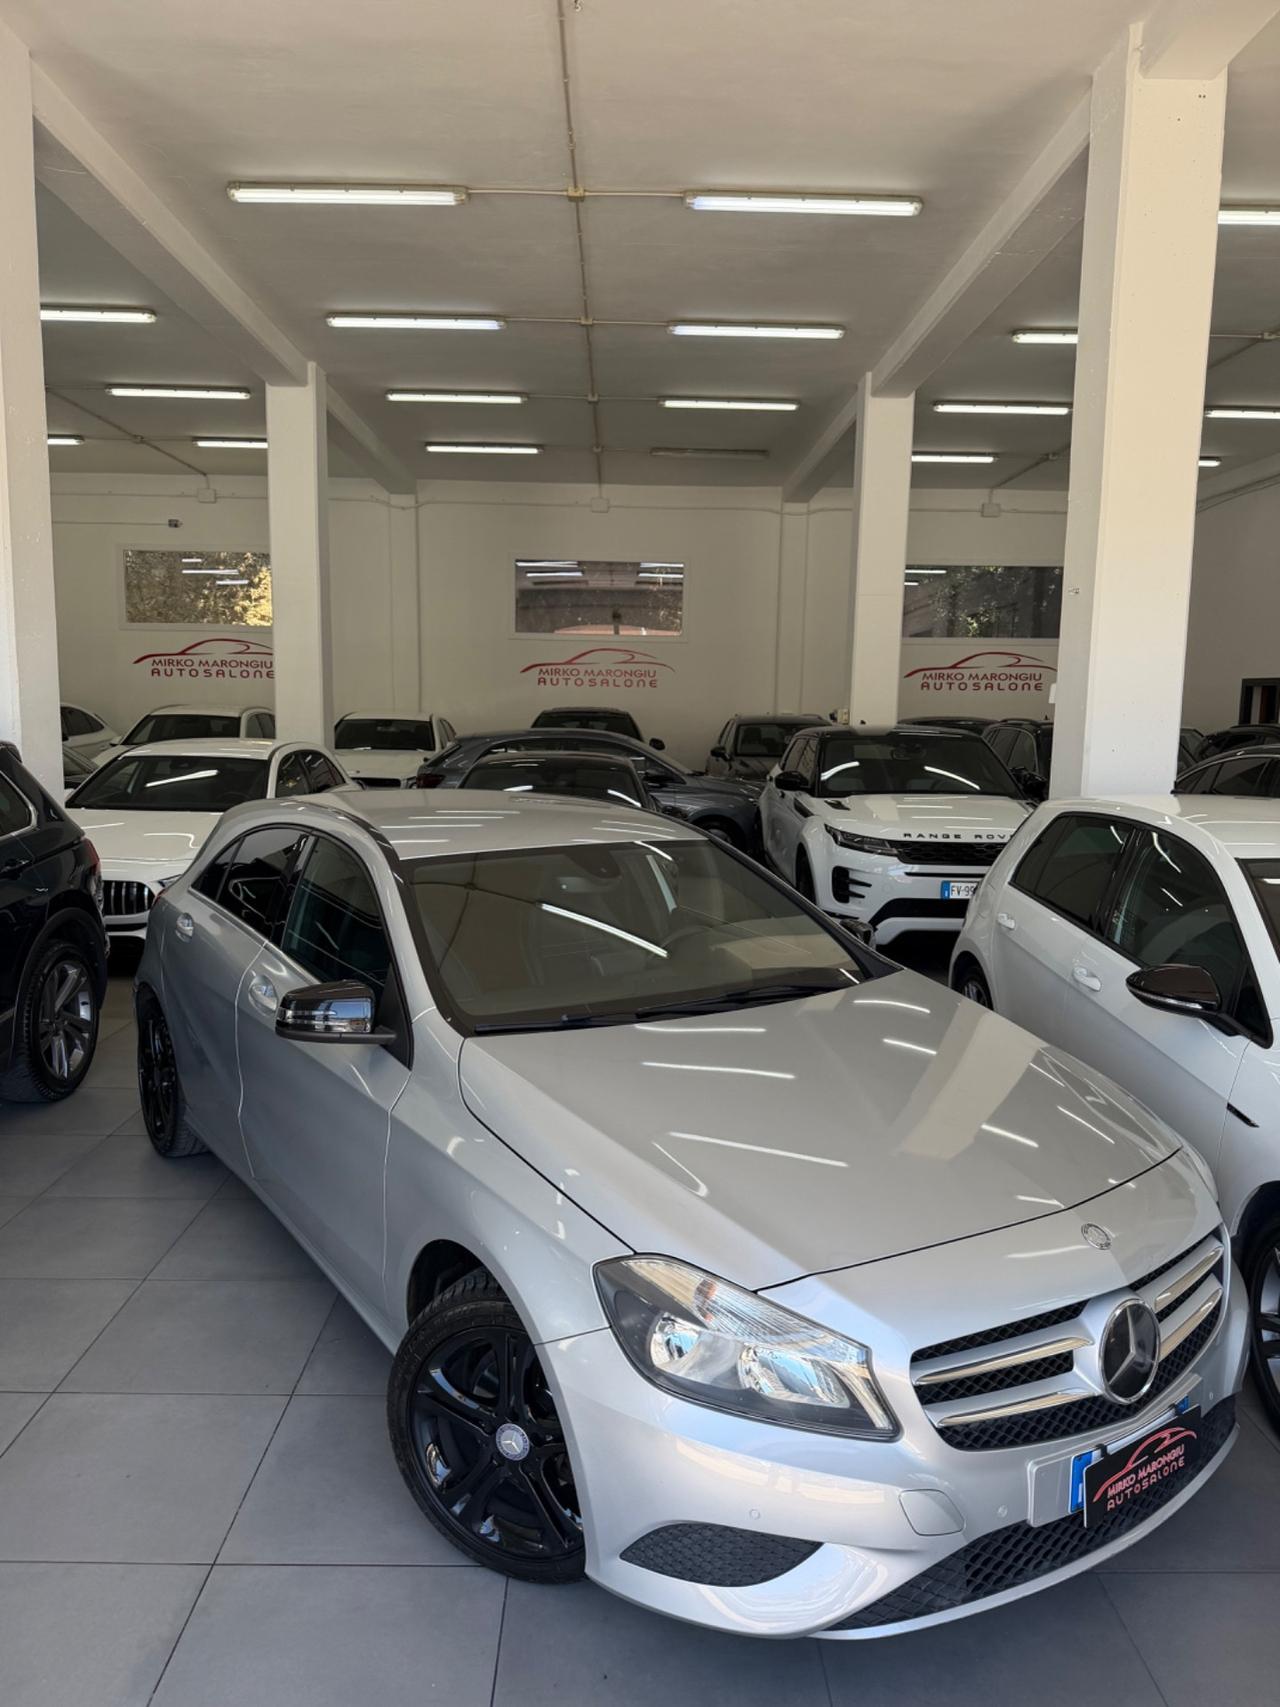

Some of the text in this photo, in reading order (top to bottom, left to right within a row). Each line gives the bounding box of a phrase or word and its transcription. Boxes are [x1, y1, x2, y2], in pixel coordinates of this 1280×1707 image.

[151, 658, 273, 669] MIRKO MARONGIU
[151, 668, 275, 679] AUTOSALONE
[538, 668, 657, 678] MIRKO MARONGIU
[922, 672, 1042, 682] MIRKO MARONGIU
[537, 677, 657, 688] AUTOSALONE
[920, 681, 1044, 692] AUTOSALONE
[1107, 1443, 1185, 1499] MIRKO MARONGIU
[1107, 1459, 1185, 1511] AUTOSALONE
